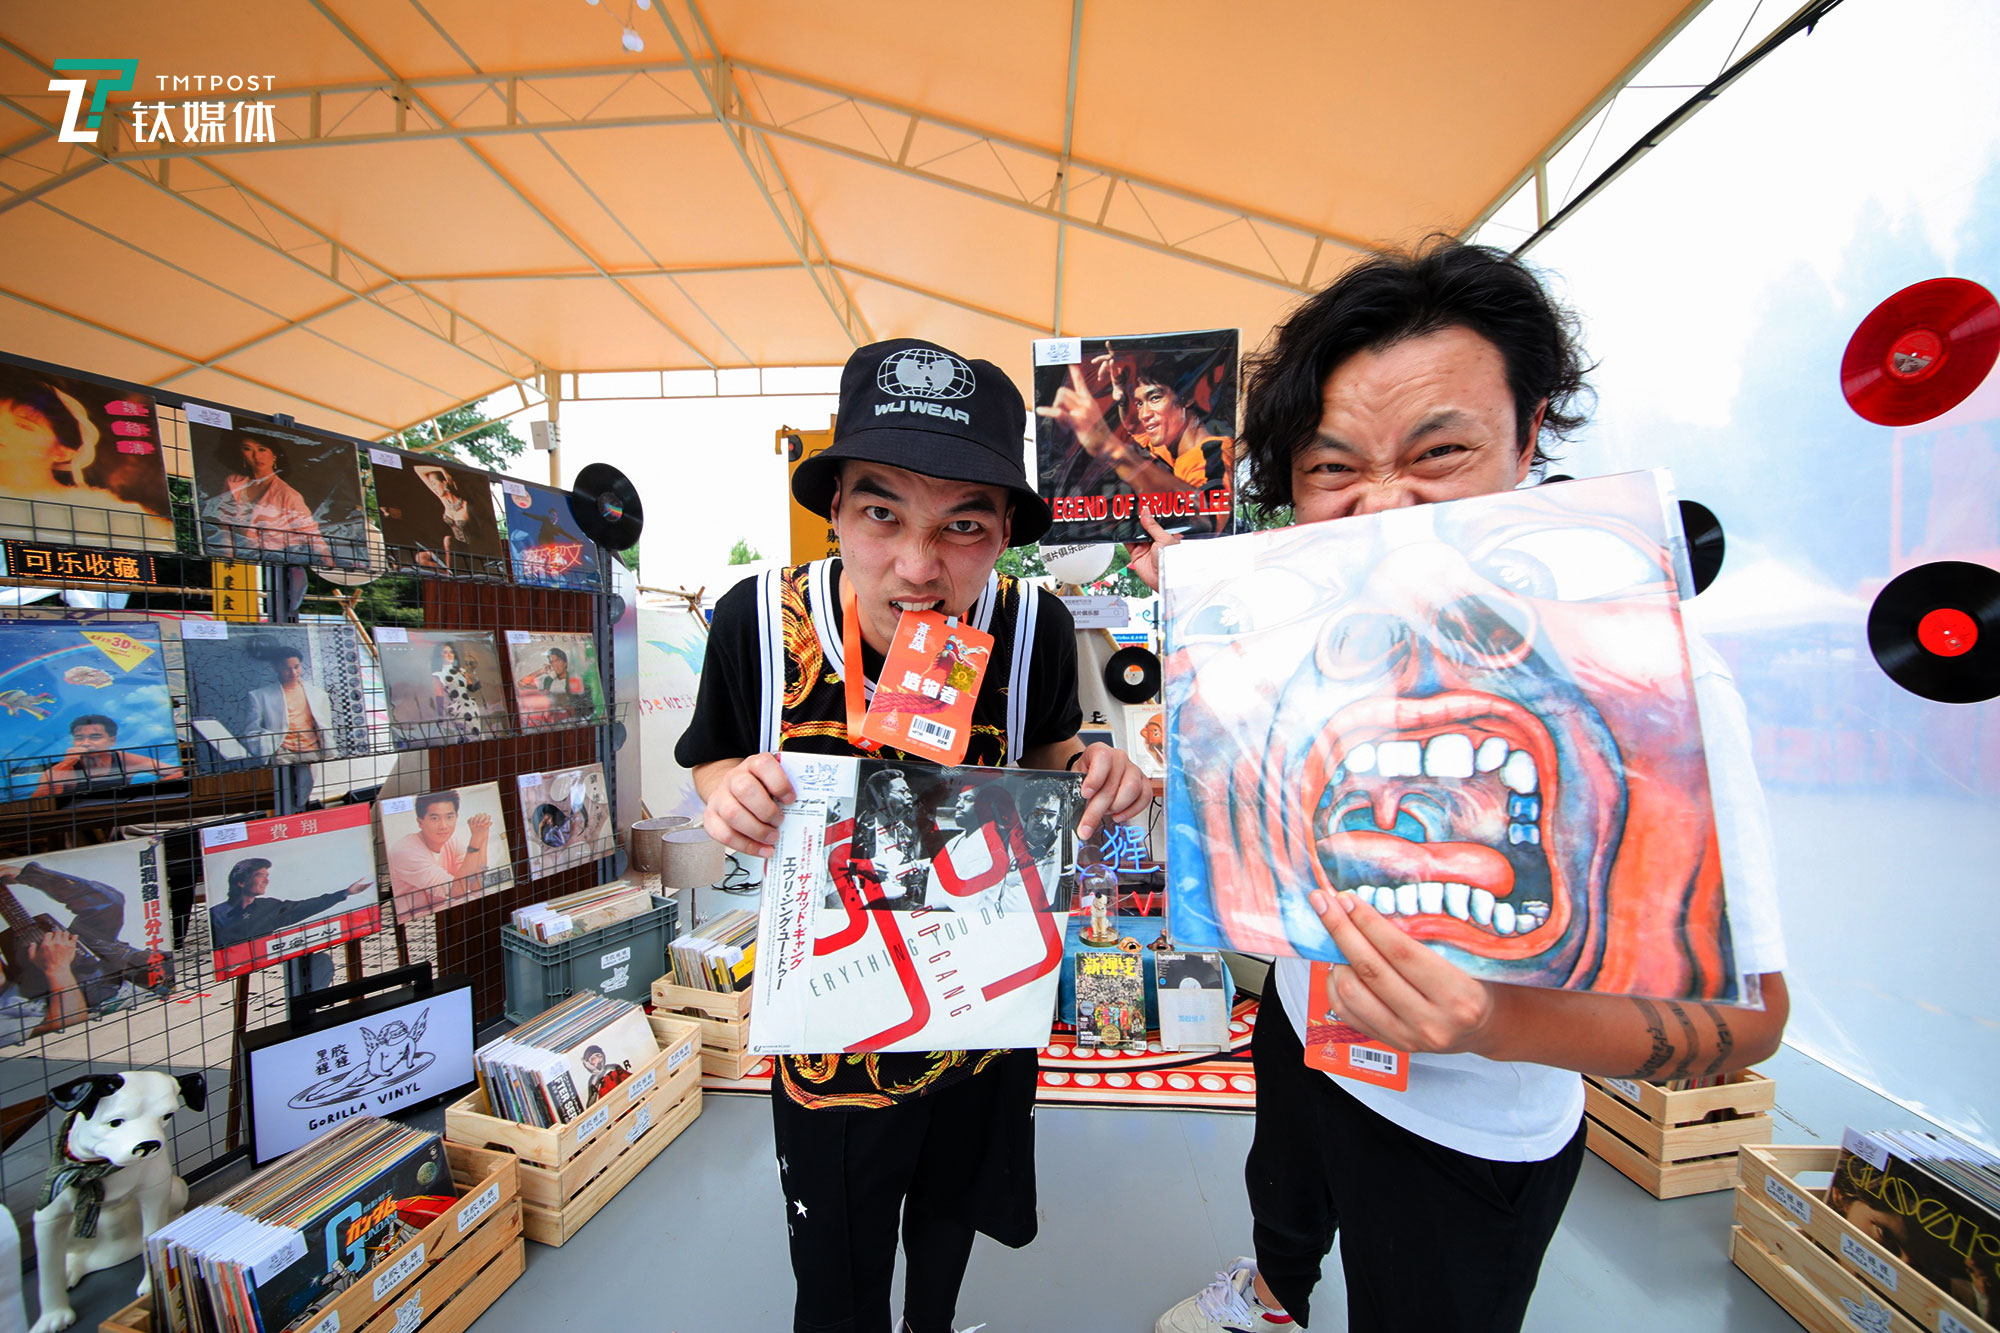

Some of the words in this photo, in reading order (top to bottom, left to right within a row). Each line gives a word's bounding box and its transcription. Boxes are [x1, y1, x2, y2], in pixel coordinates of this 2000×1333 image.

[874, 400, 906, 416] WU
[909, 400, 970, 425] WEAR
[1112, 494, 1135, 521] OF
[1199, 489, 1231, 516] LEE
[21, 548, 141, 580] 可乐收藏
[111, 636, 132, 650] 3D
[901, 670, 959, 706] 造物者
[931, 917, 969, 947] YOU
[928, 950, 972, 1017] GANG
[377, 1082, 421, 1105] VINYL
